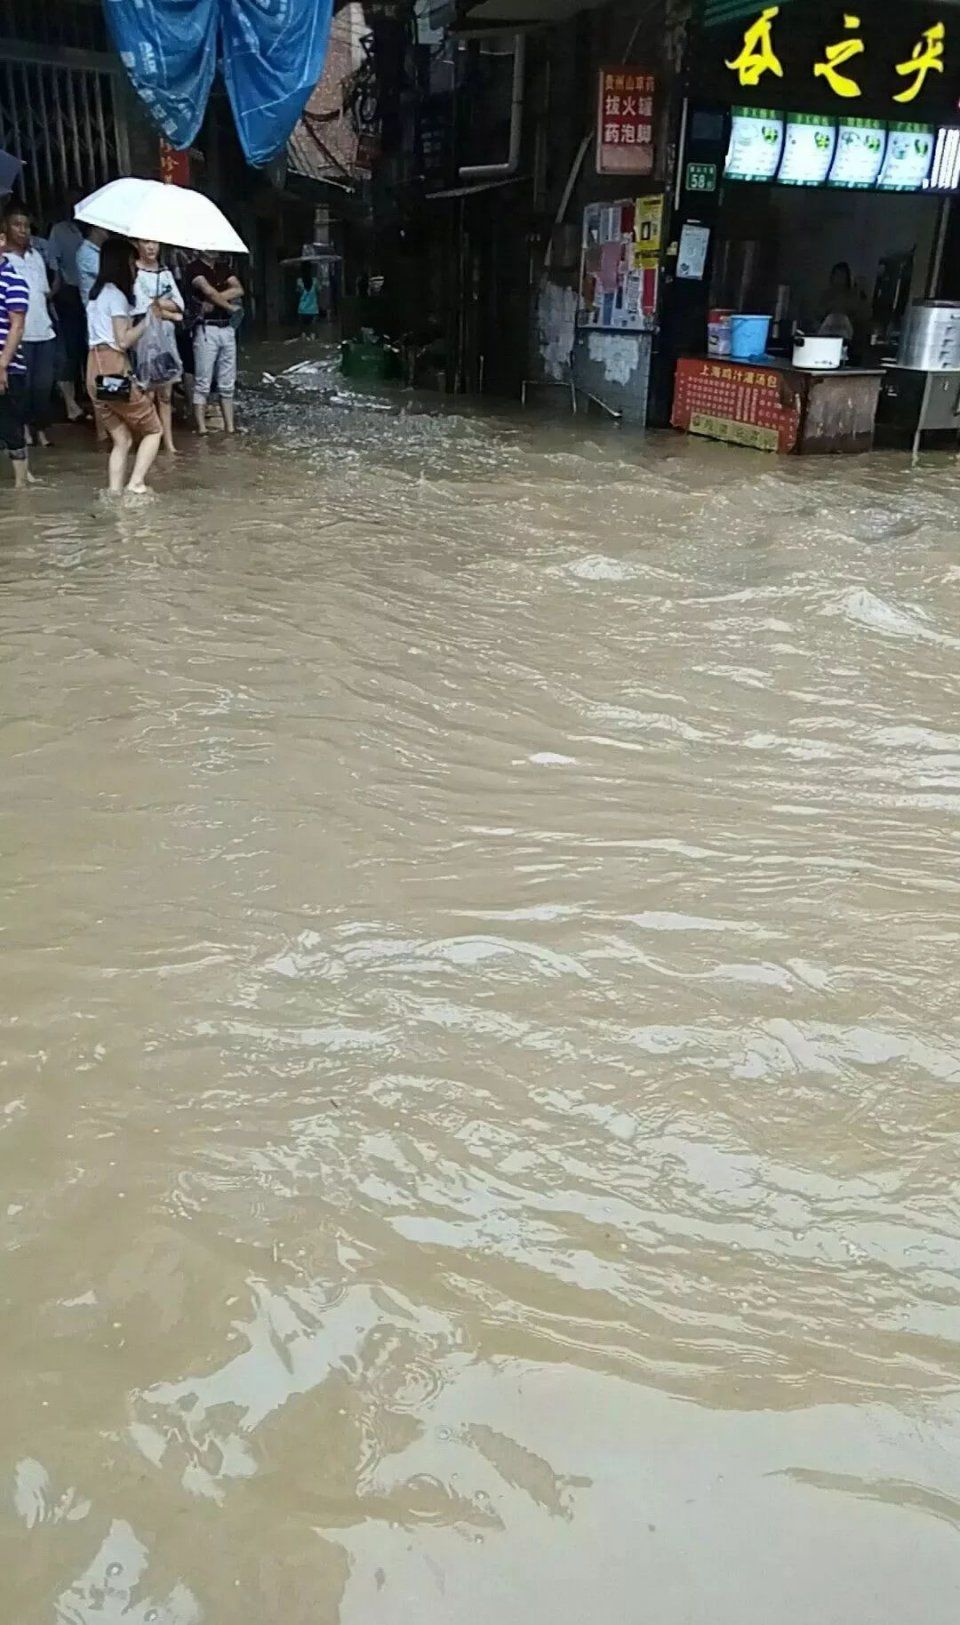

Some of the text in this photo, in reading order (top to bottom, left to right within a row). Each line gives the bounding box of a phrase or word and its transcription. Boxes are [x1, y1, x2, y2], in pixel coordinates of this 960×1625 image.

[605, 95, 653, 116] 拔火罐
[604, 124, 652, 143] 药泡脚
